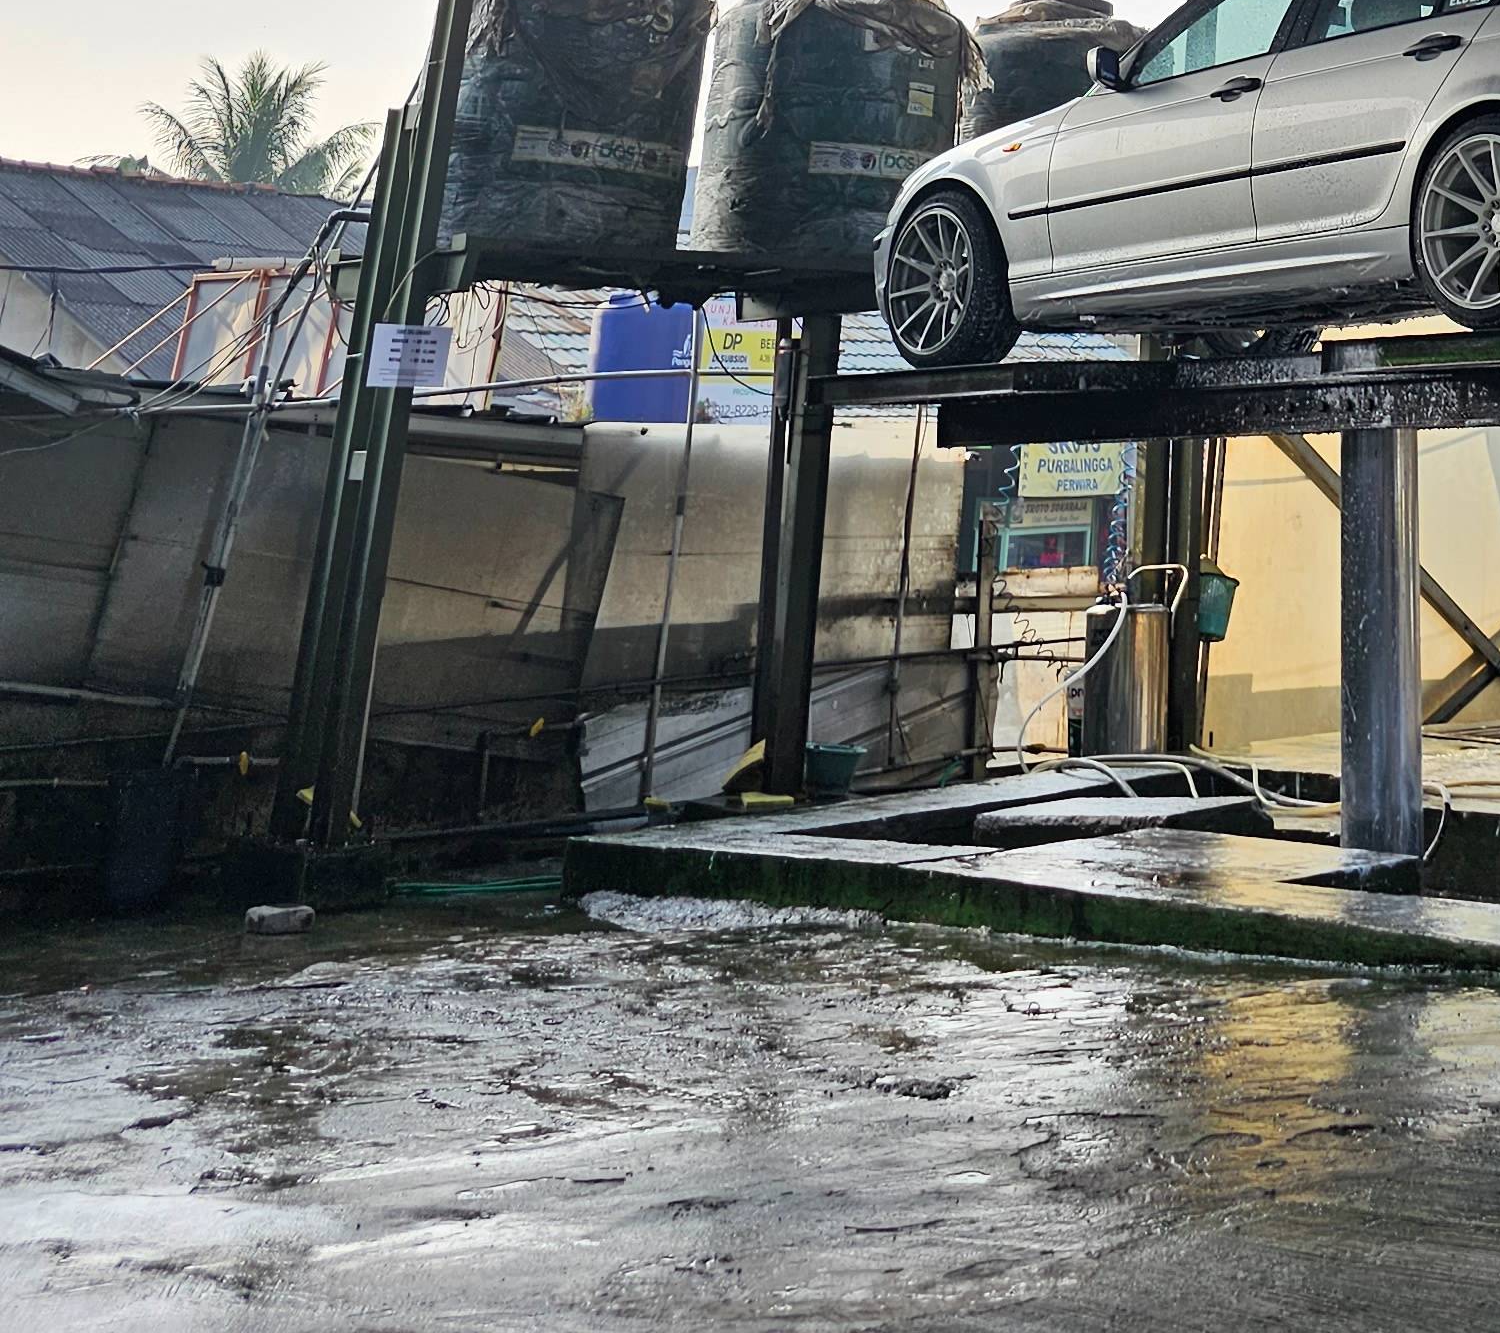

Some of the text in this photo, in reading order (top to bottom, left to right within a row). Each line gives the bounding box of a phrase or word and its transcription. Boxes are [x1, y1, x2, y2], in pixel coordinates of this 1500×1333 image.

[723, 332, 743, 350] DP
[1037, 457, 1114, 474] PURBALINGGA
[1056, 478, 1098, 492] PERWIRA
